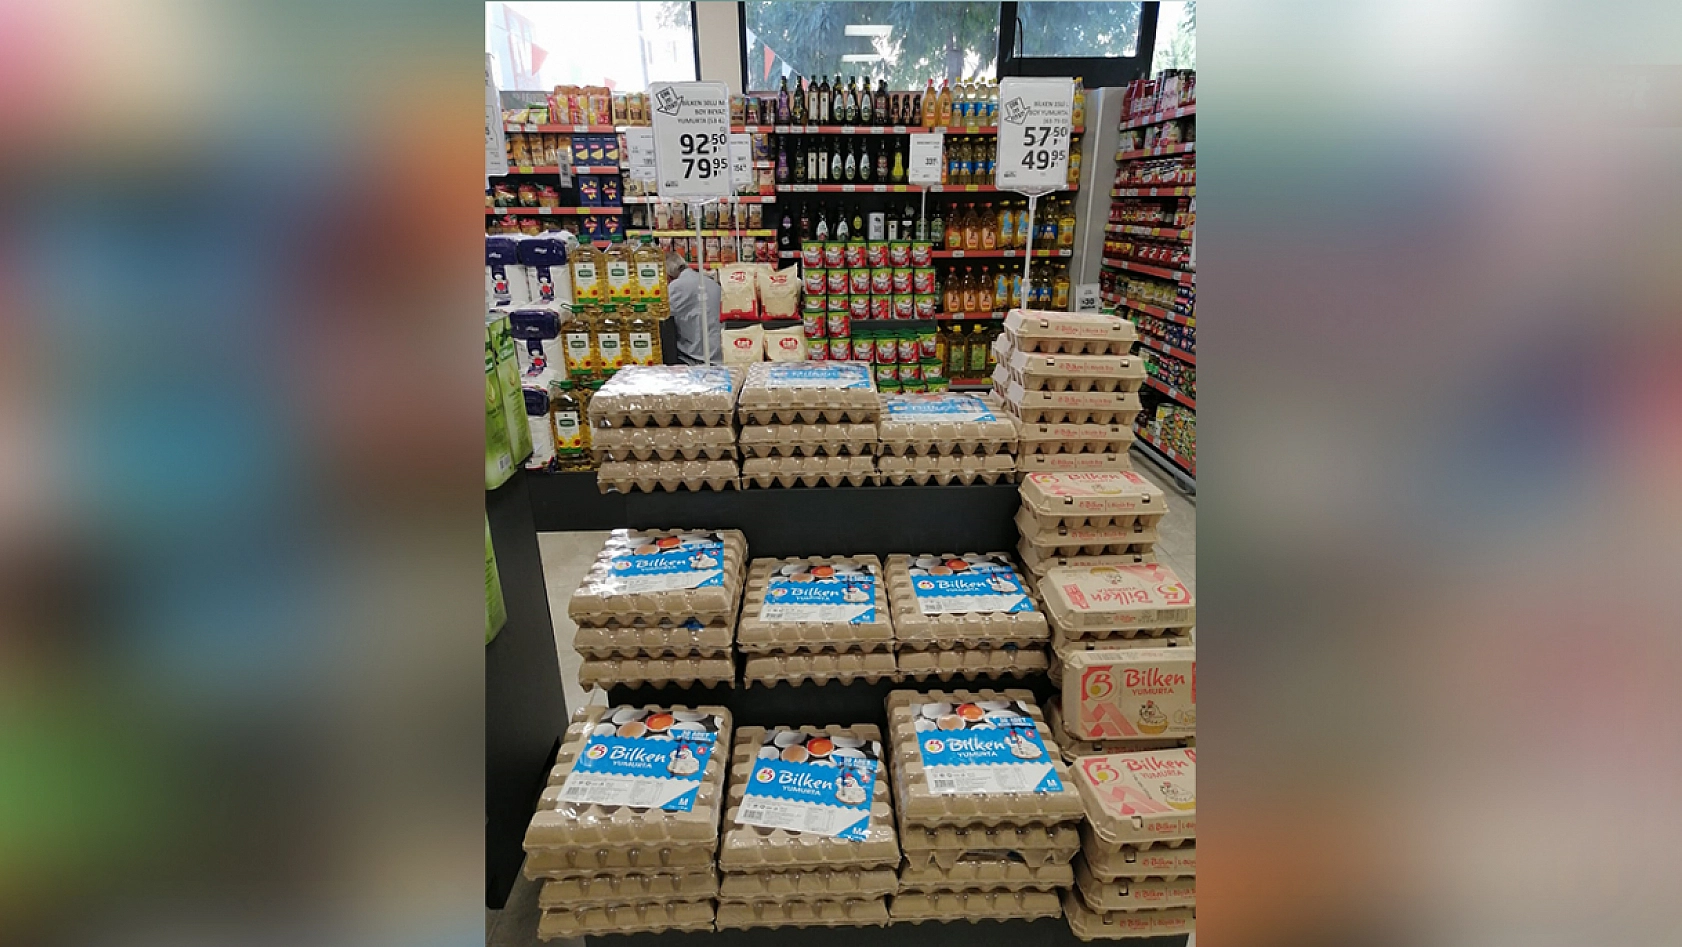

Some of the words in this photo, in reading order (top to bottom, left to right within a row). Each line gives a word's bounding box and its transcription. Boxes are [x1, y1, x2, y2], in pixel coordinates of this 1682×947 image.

[936, 579, 986, 590] Bilken
[791, 588, 840, 597] Bilken
[1091, 590, 1153, 605] Bilken
[1123, 668, 1186, 688] Bilken
[945, 736, 1005, 754] Bilken
[609, 746, 666, 763] Bilken
[612, 761, 653, 769] YUMURTA
[1121, 757, 1189, 772] Bilken
[778, 770, 832, 791] Bilken
[1141, 771, 1184, 780] YUMURTA
[782, 786, 822, 796] YUMURTA
[1127, 919, 1149, 927] Bilken
